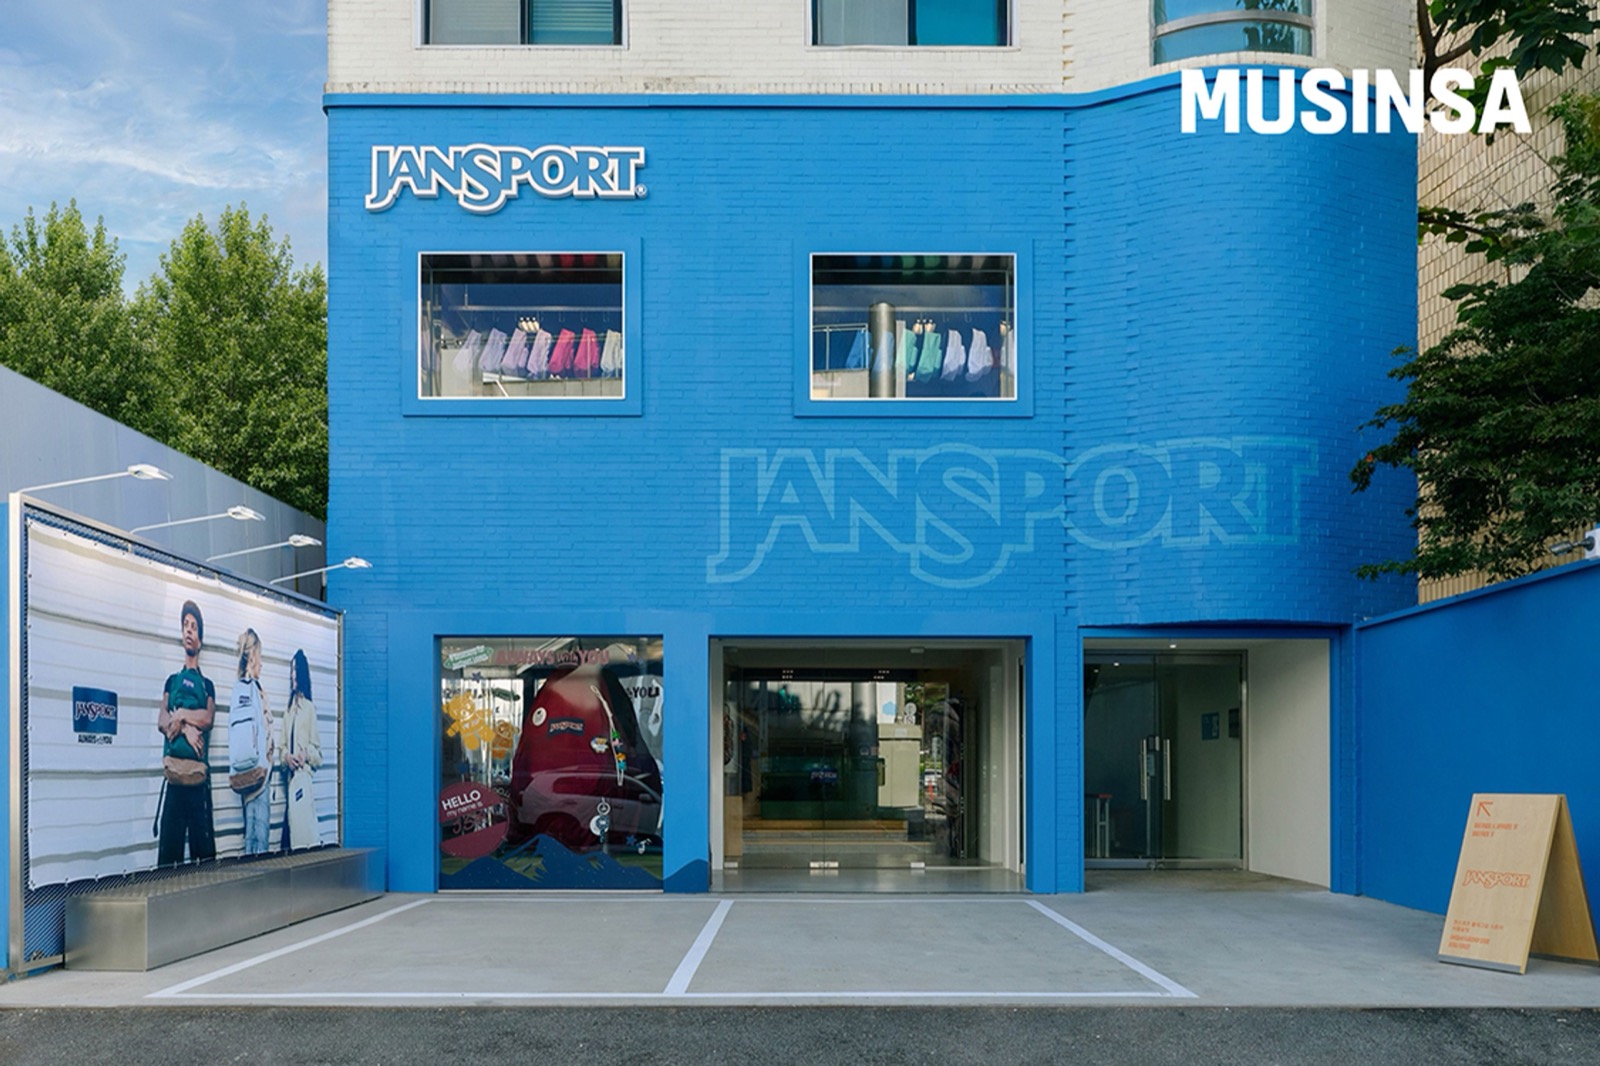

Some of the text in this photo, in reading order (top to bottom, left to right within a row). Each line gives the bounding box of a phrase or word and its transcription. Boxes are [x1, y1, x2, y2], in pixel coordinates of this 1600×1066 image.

[365, 143, 646, 214] JANSPORT
[706, 435, 1319, 588] JANSPORT
[441, 789, 481, 811] HELLO
[1462, 869, 1531, 889] JANSPORT
